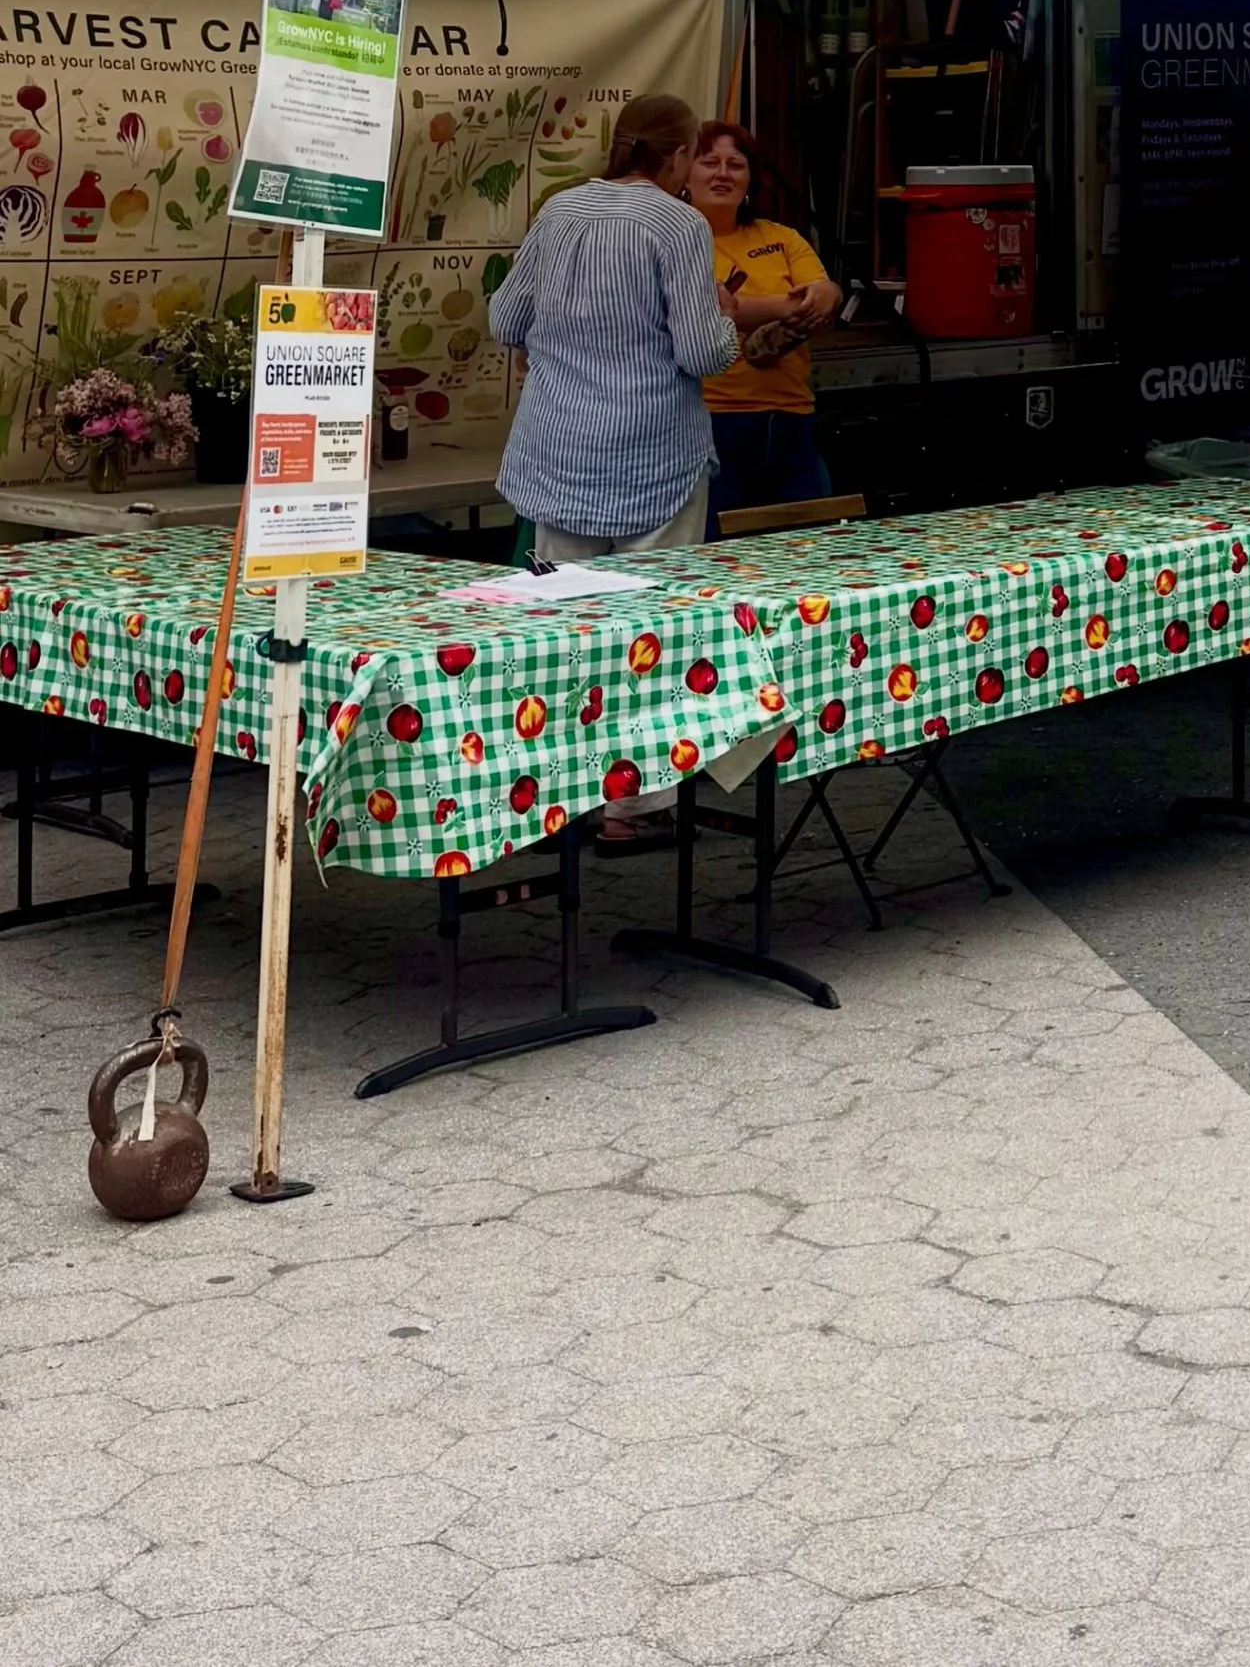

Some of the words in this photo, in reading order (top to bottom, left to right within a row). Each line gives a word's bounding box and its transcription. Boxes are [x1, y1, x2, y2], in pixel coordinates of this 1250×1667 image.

[277, 20, 333, 43] GrowNYC
[335, 31, 346, 47] is
[348, 34, 386, 56] Hiring!
[1142, 22, 1235, 51] UNION
[0, 50, 36, 69] shop
[41, 54, 55, 66] at
[60, 56, 94, 71] your
[99, 56, 135, 70] local
[140, 58, 216, 73] GrowNYC
[416, 66, 430, 77] or
[435, 64, 484, 77] donate
[488, 65, 501, 77] at
[122, 89, 167, 104] MAR
[457, 89, 495, 102] MAY
[587, 89, 633, 102] JUNE
[433, 256, 473, 270] NOV
[109, 269, 162, 284] SEPT
[267, 345, 312, 361] UNION
[317, 346, 366, 363] SQUARE
[265, 364, 366, 387] GREENMARKET
[1140, 358, 1235, 401] GROW
